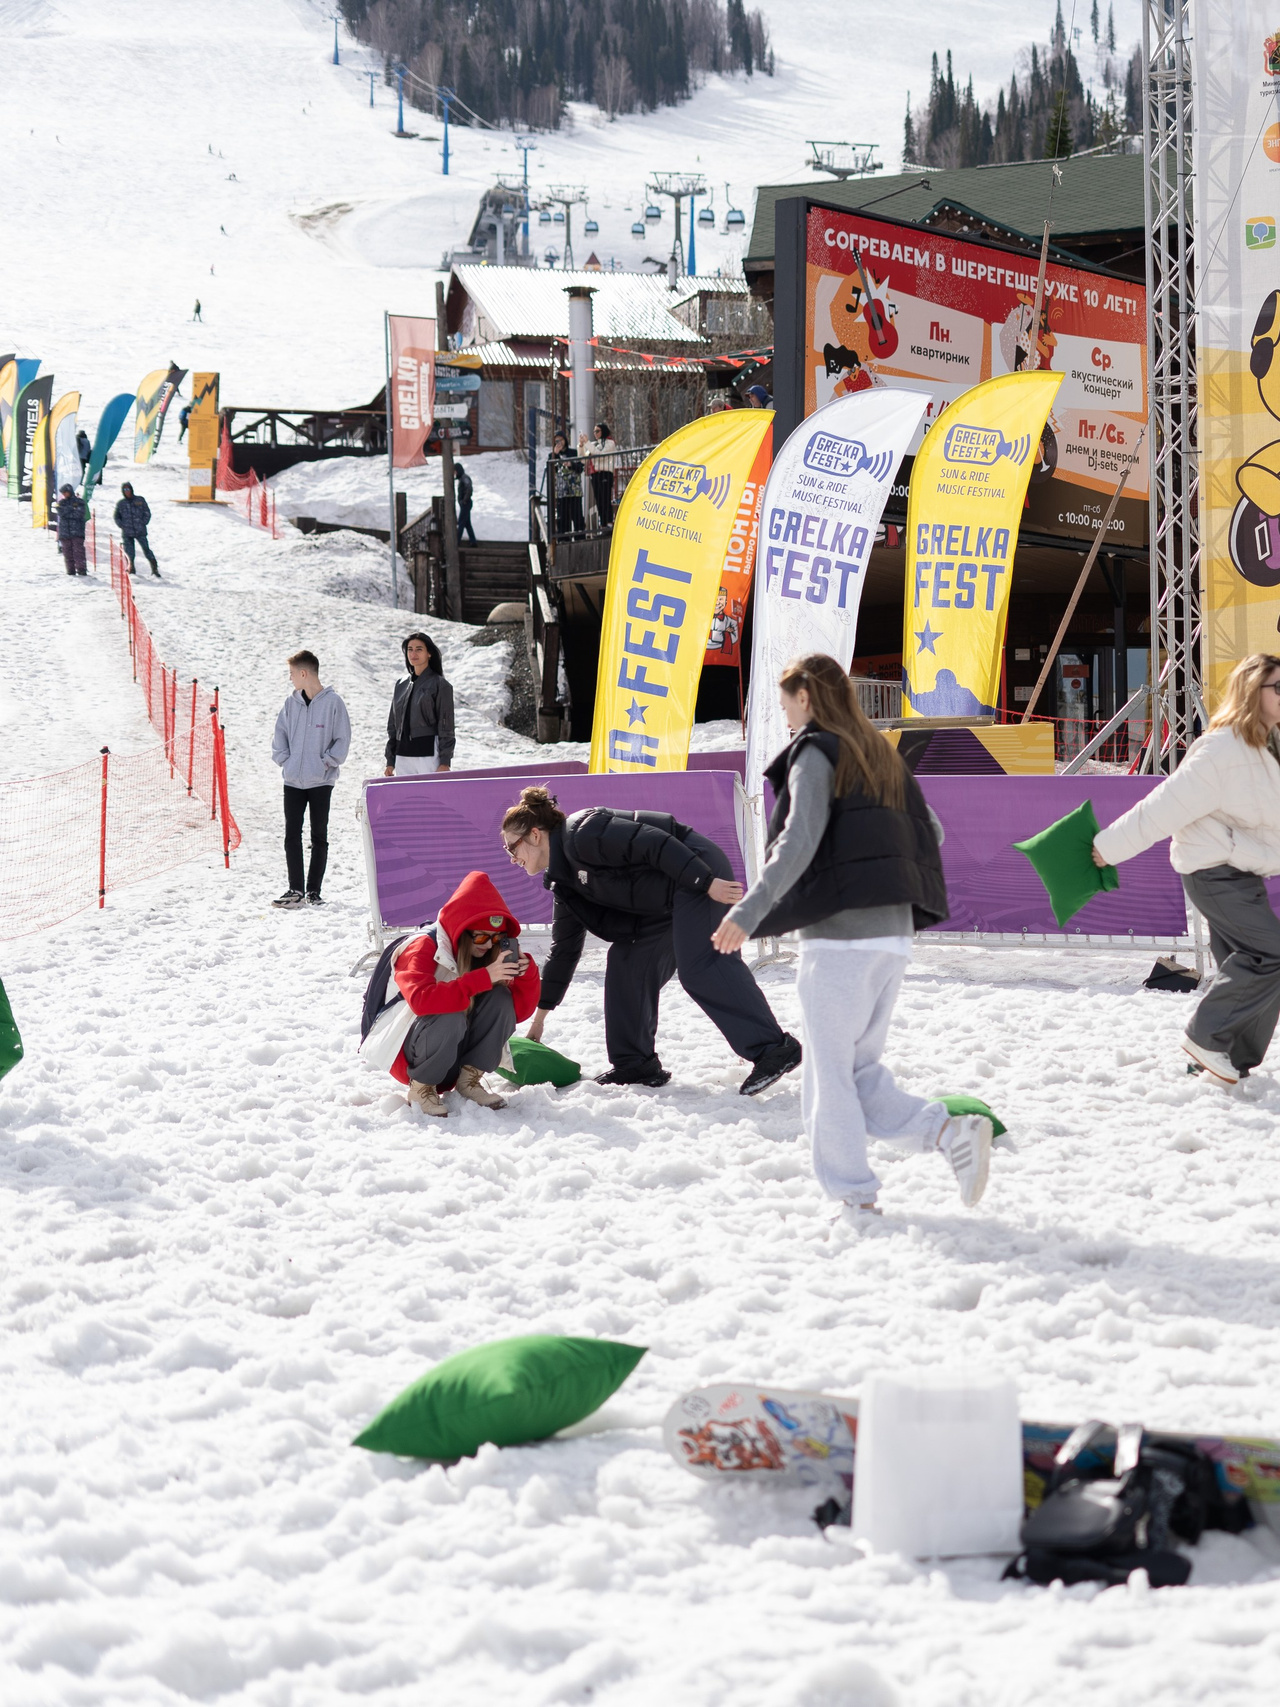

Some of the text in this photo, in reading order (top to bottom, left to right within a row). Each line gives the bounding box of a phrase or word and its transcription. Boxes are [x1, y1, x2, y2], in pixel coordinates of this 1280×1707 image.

[824, 227, 1137, 316] СОГРЕВАЕМ В ШЕРЕГЕШЕ УЖЕ 10 ЛЕТ!
[929, 321, 953, 343] Пн.
[910, 344, 971, 366] квартирник
[1091, 346, 1114, 371] Ср.
[1071, 369, 1134, 390] акустический
[397, 355, 421, 430] GRELKA
[1083, 383, 1122, 401] концерт
[816, 437, 860, 461] GRELKA
[955, 429, 997, 447] GRELKA
[811, 451, 842, 470] FEST
[951, 444, 981, 459] FEST
[1065, 443, 1140, 465] днем и вечером
[660, 464, 702, 482] GRELKA
[1088, 456, 1119, 472] Dj-sets
[655, 478, 683, 494] FEST
[797, 474, 849, 495] SUN & RIDE
[940, 468, 990, 483] SUN & RIDE
[792, 489, 863, 514] MUSIC FESTIVAL
[936, 483, 1006, 499] MUSIC FESTIVAL
[641, 500, 689, 522] SUN & RIDE
[1083, 504, 1101, 514] пт-сб
[636, 516, 703, 544] MUSIC FESTIVAL
[1065, 511, 1090, 526] 10:00
[1091, 518, 1103, 530] до
[768, 507, 869, 559] GRELKA
[916, 522, 1010, 559] GRELKA
[743, 538, 756, 575] БЫСТРО
[766, 545, 860, 609] FEST
[913, 561, 1006, 612] FEST
[617, 548, 693, 698] FEST
